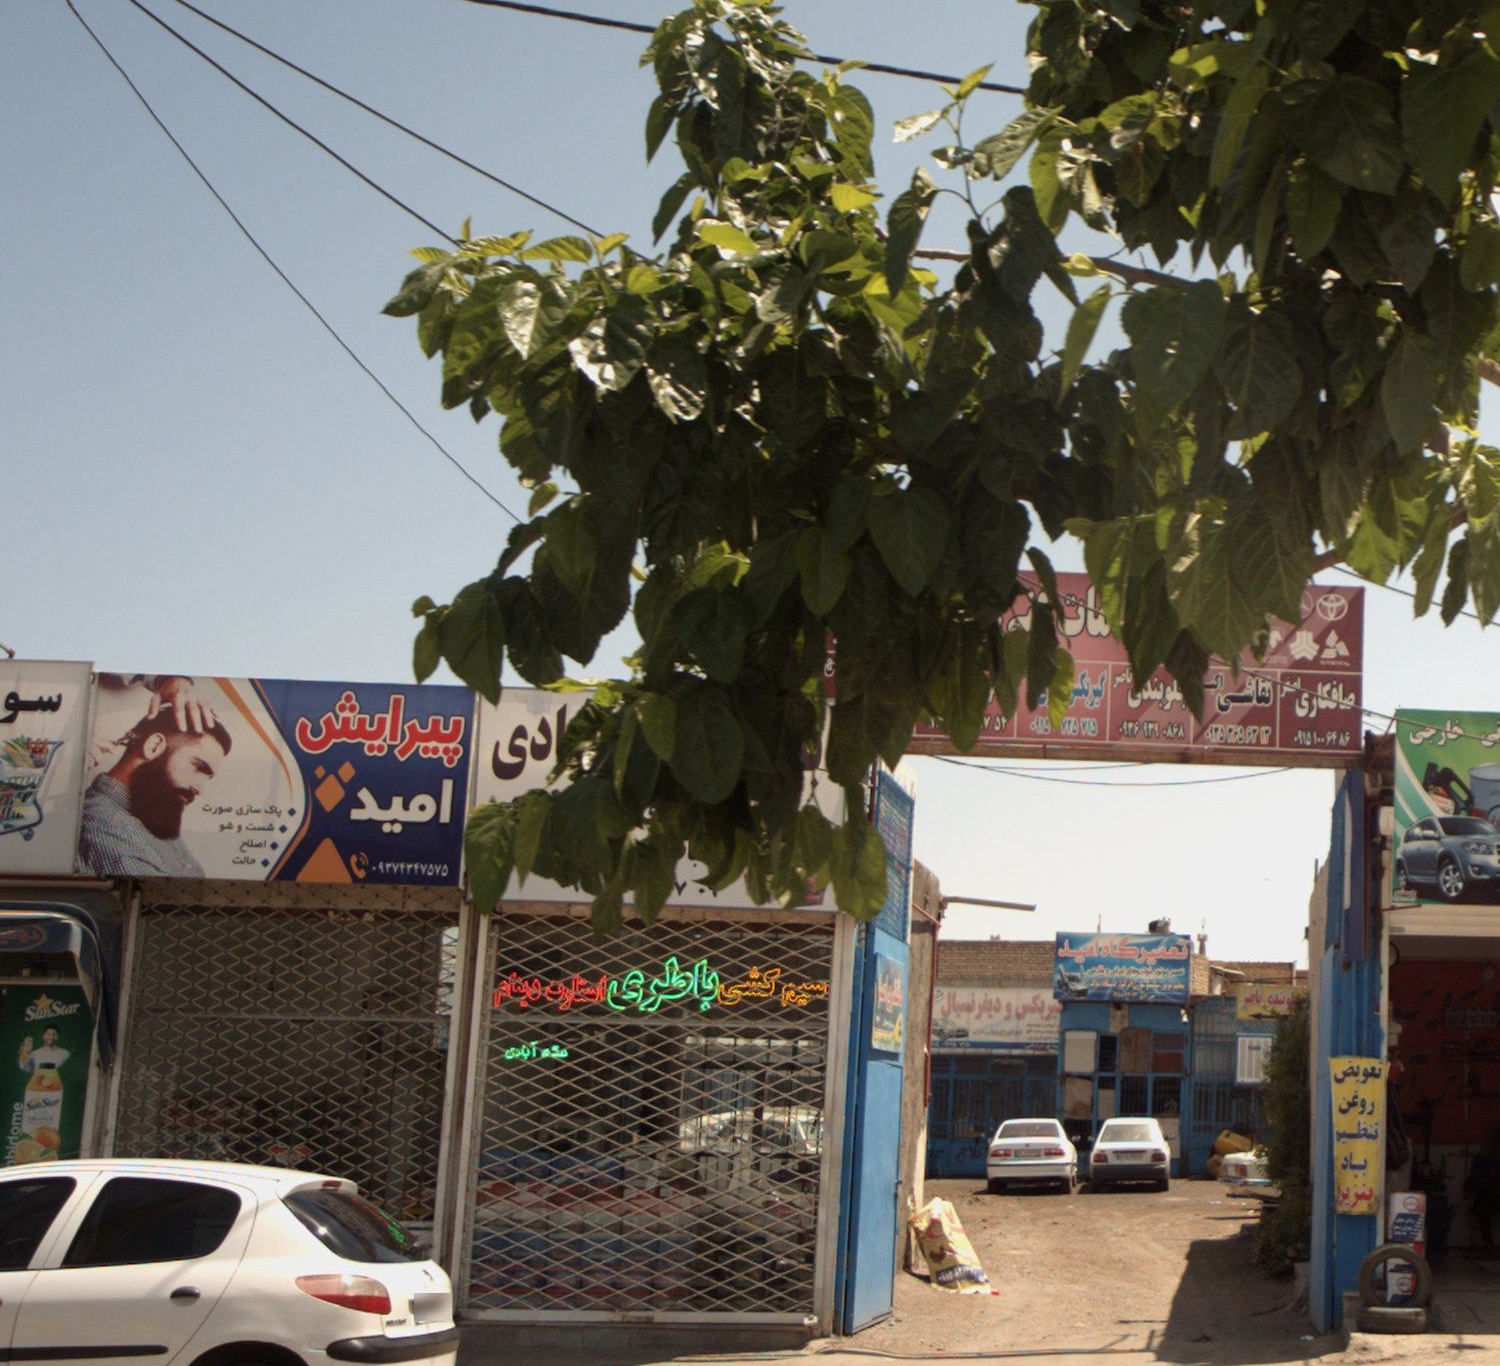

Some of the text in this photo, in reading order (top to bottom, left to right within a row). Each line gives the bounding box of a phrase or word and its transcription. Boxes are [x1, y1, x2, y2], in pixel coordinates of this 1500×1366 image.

[1216, 676, 1274, 714] نقاشی
[1295, 680, 1356, 718] صافکاری
[296, 691, 465, 768] پیرایش
[1409, 718, 1464, 747] خارجی
[202, 803, 282, 818] پاک سازی صورت
[350, 778, 454, 833] امید
[239, 839, 267, 853] اصلاح
[1057, 935, 1190, 966] تعمیرگاه امید
[607, 955, 719, 1013] باطری
[718, 965, 781, 1007] کشی
[25, 1000, 81, 1022] SunStar
[1004, 1000, 1012, 1020] و
[1334, 1060, 1383, 1084] تعویض
[1337, 1090, 1375, 1115] روغن
[1341, 1151, 1368, 1175] باد
